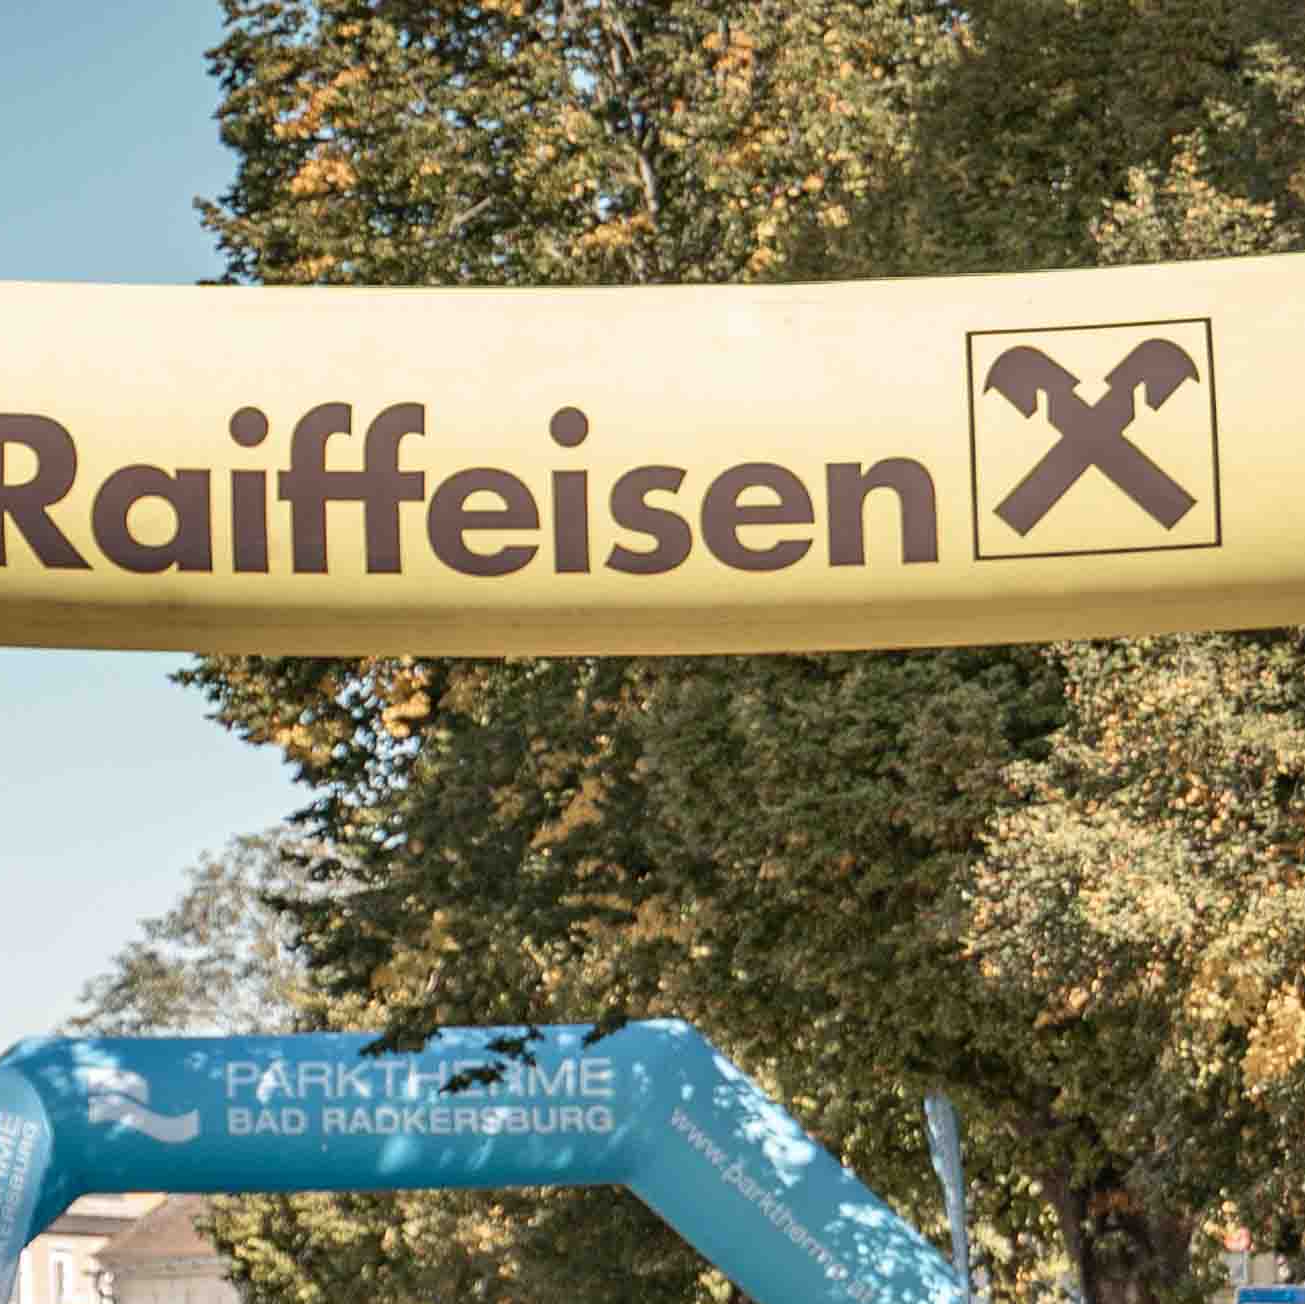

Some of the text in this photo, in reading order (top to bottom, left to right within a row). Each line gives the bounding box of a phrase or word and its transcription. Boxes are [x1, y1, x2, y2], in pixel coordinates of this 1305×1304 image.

[226, 1057, 614, 1100] PARKTHERME
[227, 1105, 615, 1136] BAD RADKERSBURG
